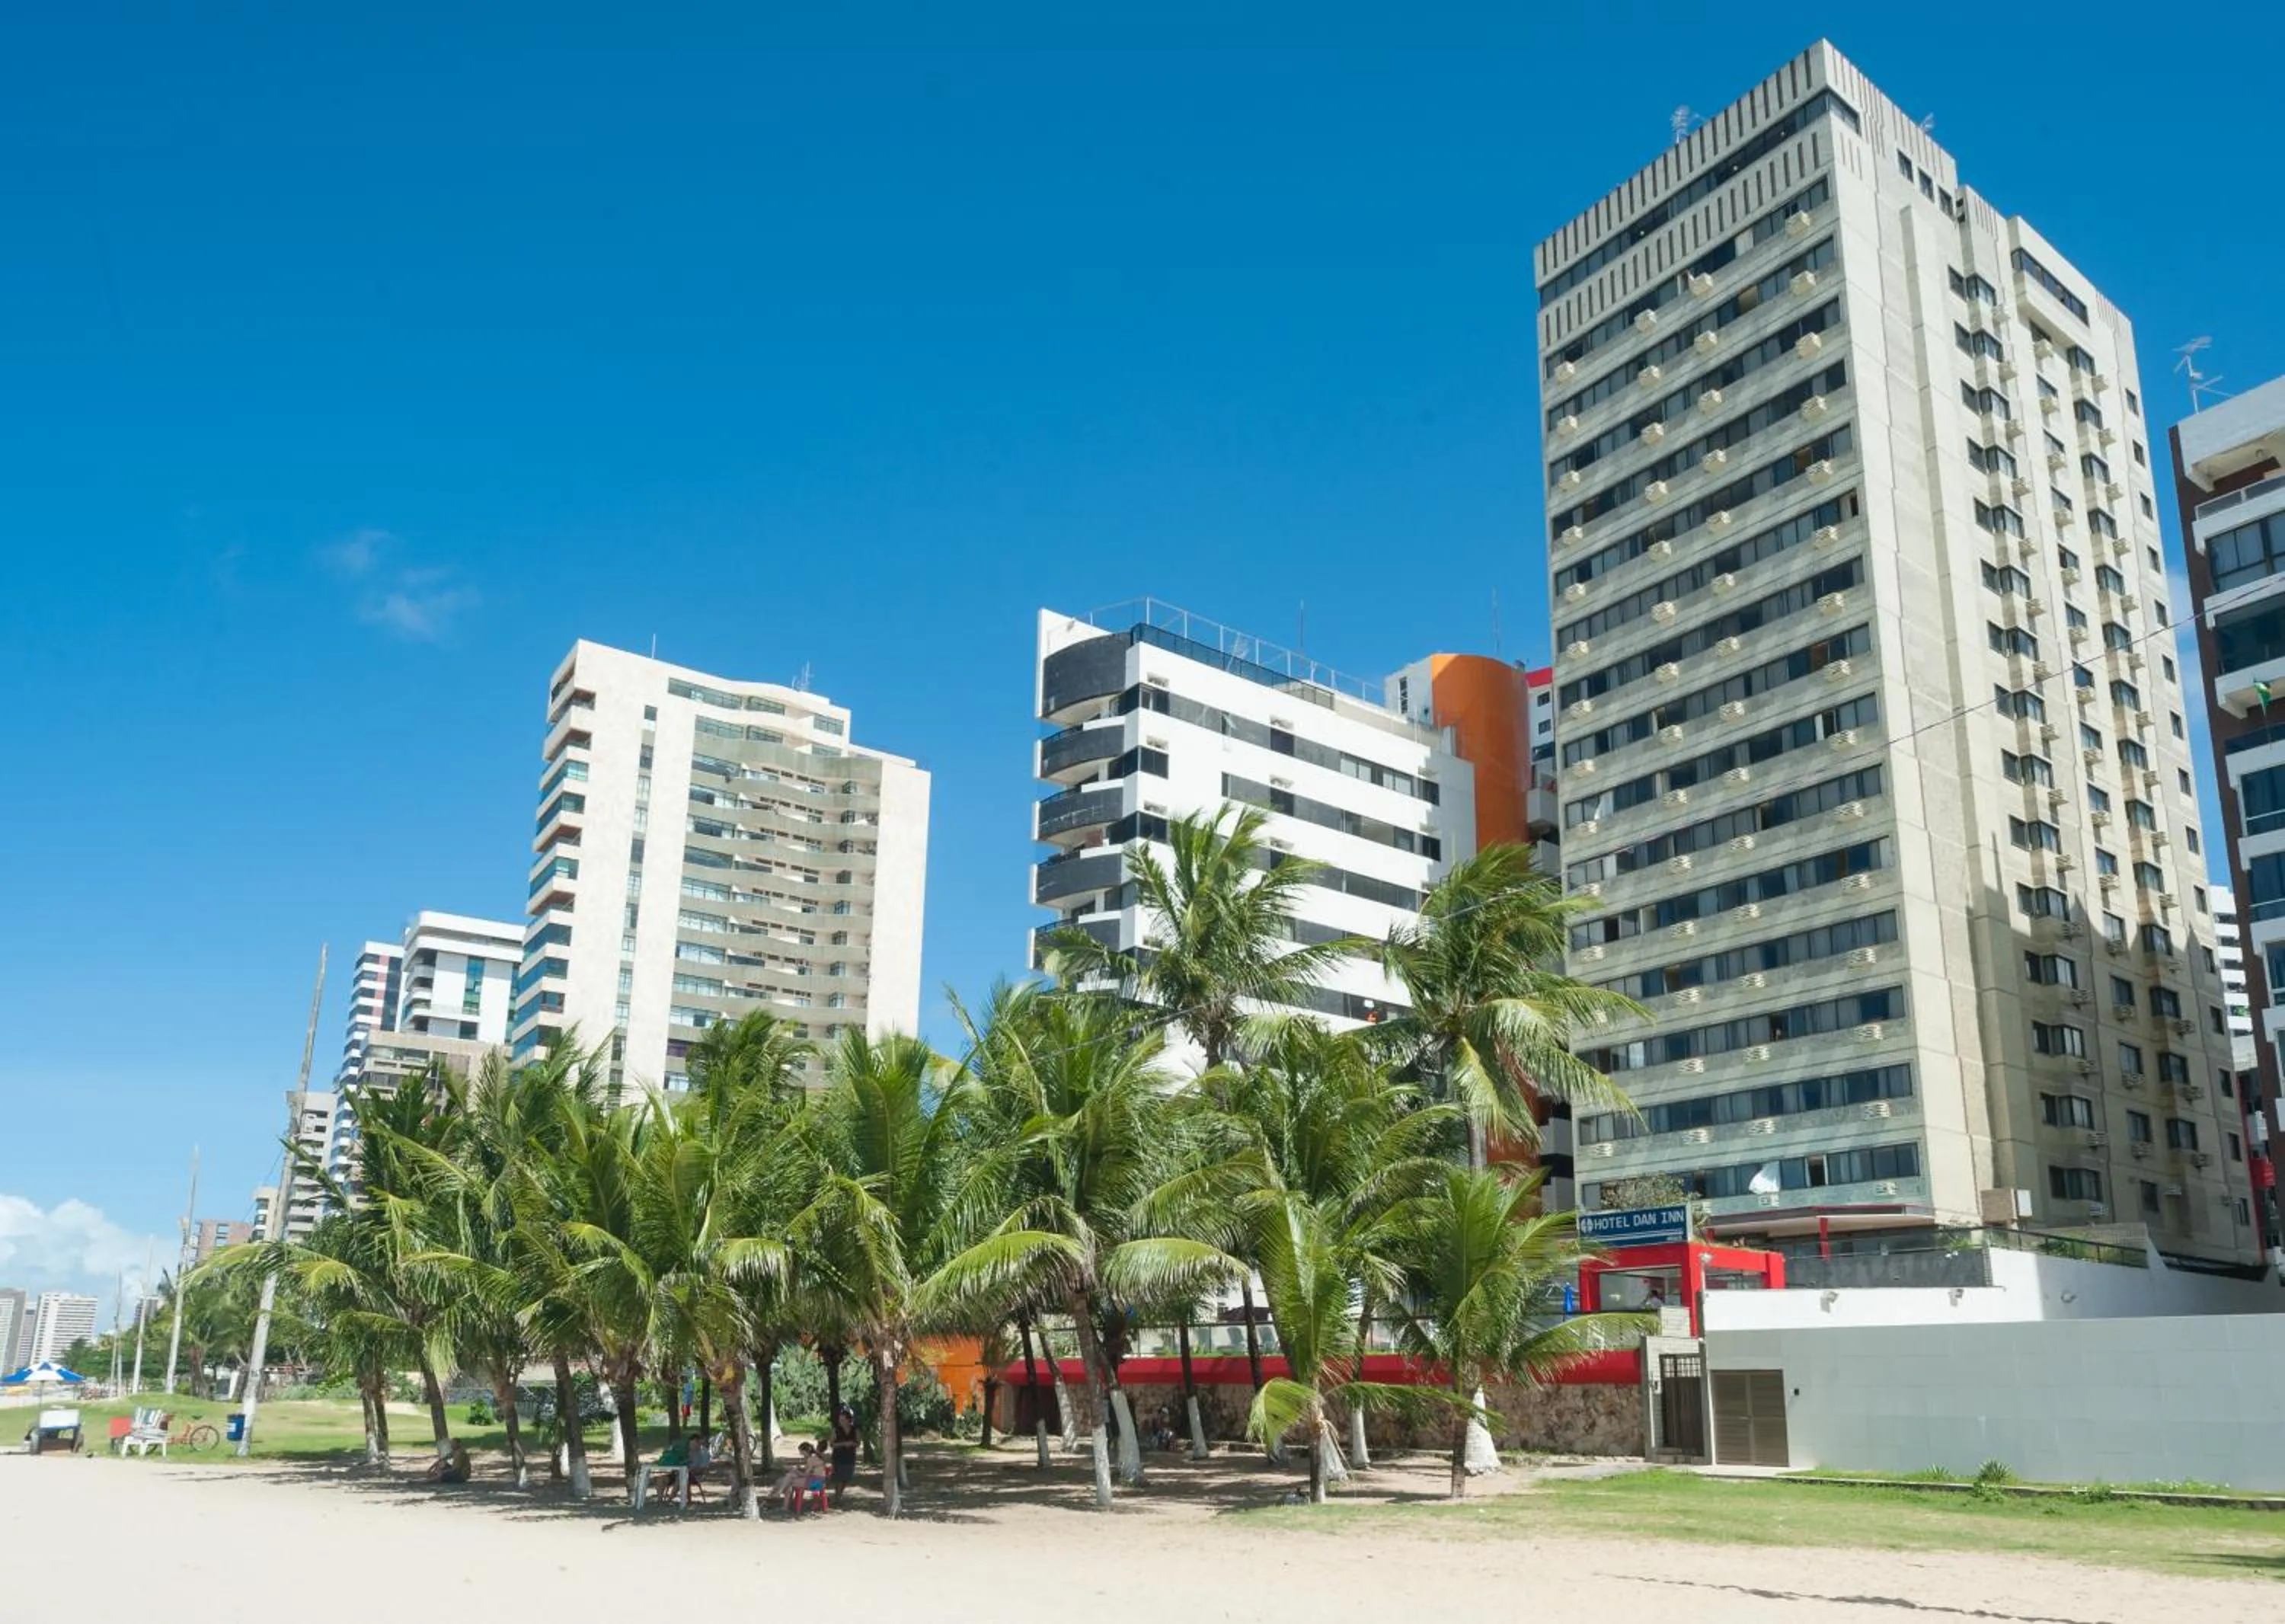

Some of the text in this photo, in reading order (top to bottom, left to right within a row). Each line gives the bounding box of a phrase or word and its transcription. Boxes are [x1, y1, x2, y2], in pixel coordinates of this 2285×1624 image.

[1594, 1210, 1685, 1230] HOTEL DAN INN
